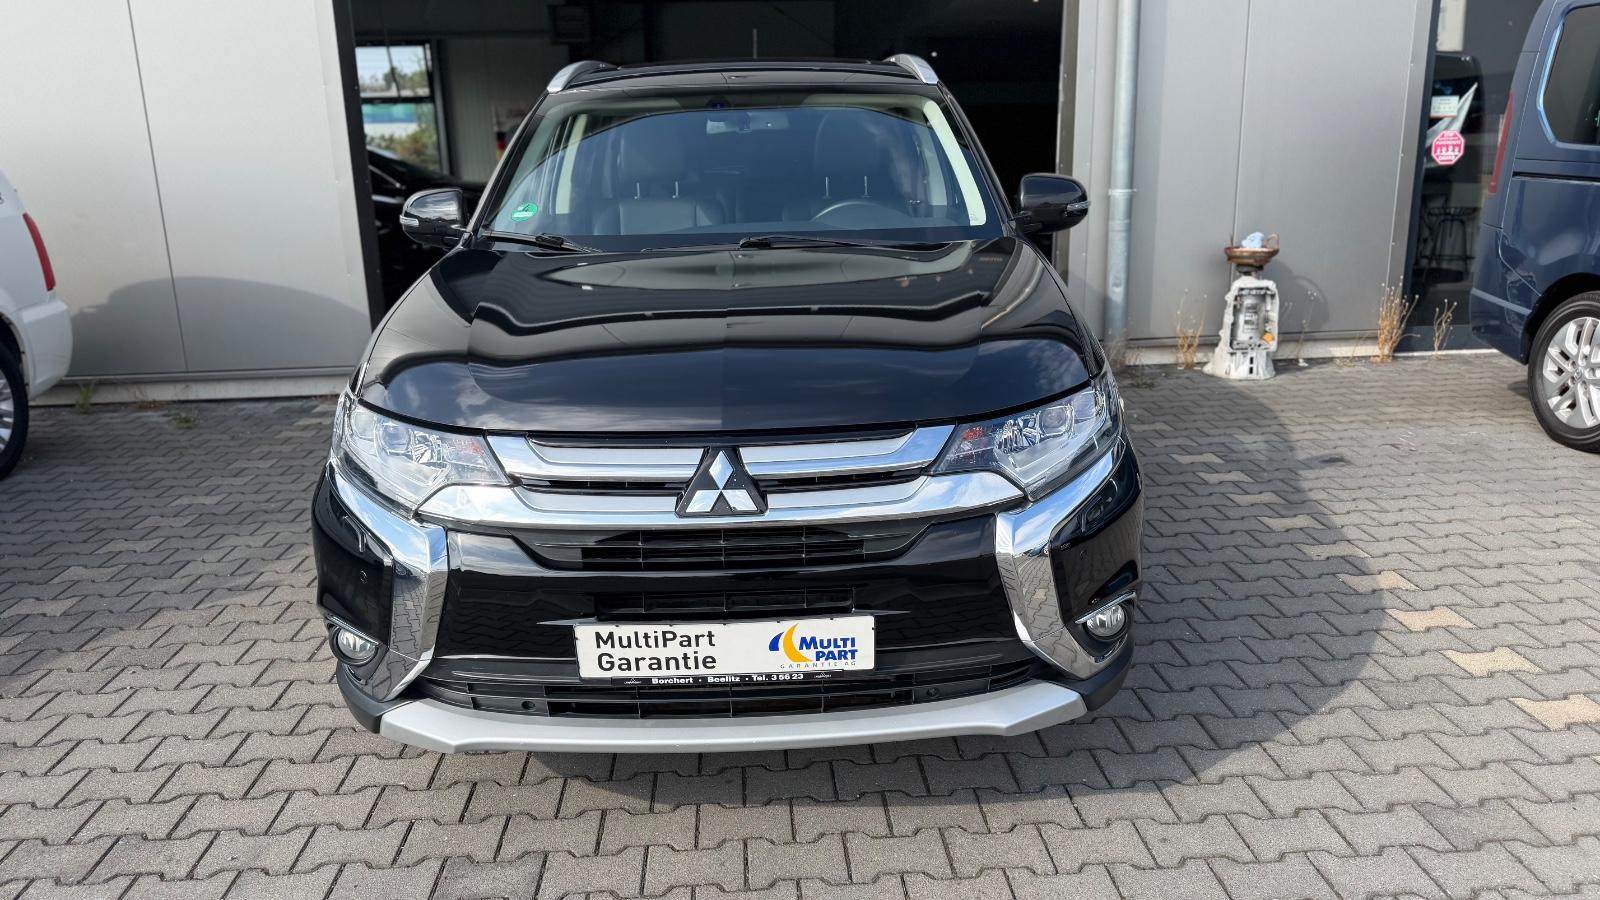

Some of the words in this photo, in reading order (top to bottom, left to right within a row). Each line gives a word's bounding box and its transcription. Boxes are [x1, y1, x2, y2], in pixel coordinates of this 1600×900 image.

[595, 631, 716, 649] MultiPart
[799, 636, 856, 650] MULTI
[597, 651, 717, 672] Garantie
[815, 649, 858, 661] PART
[780, 661, 838, 669] GARANTIE
[651, 677, 694, 685] Borchert
[751, 674, 769, 682] Tel.
